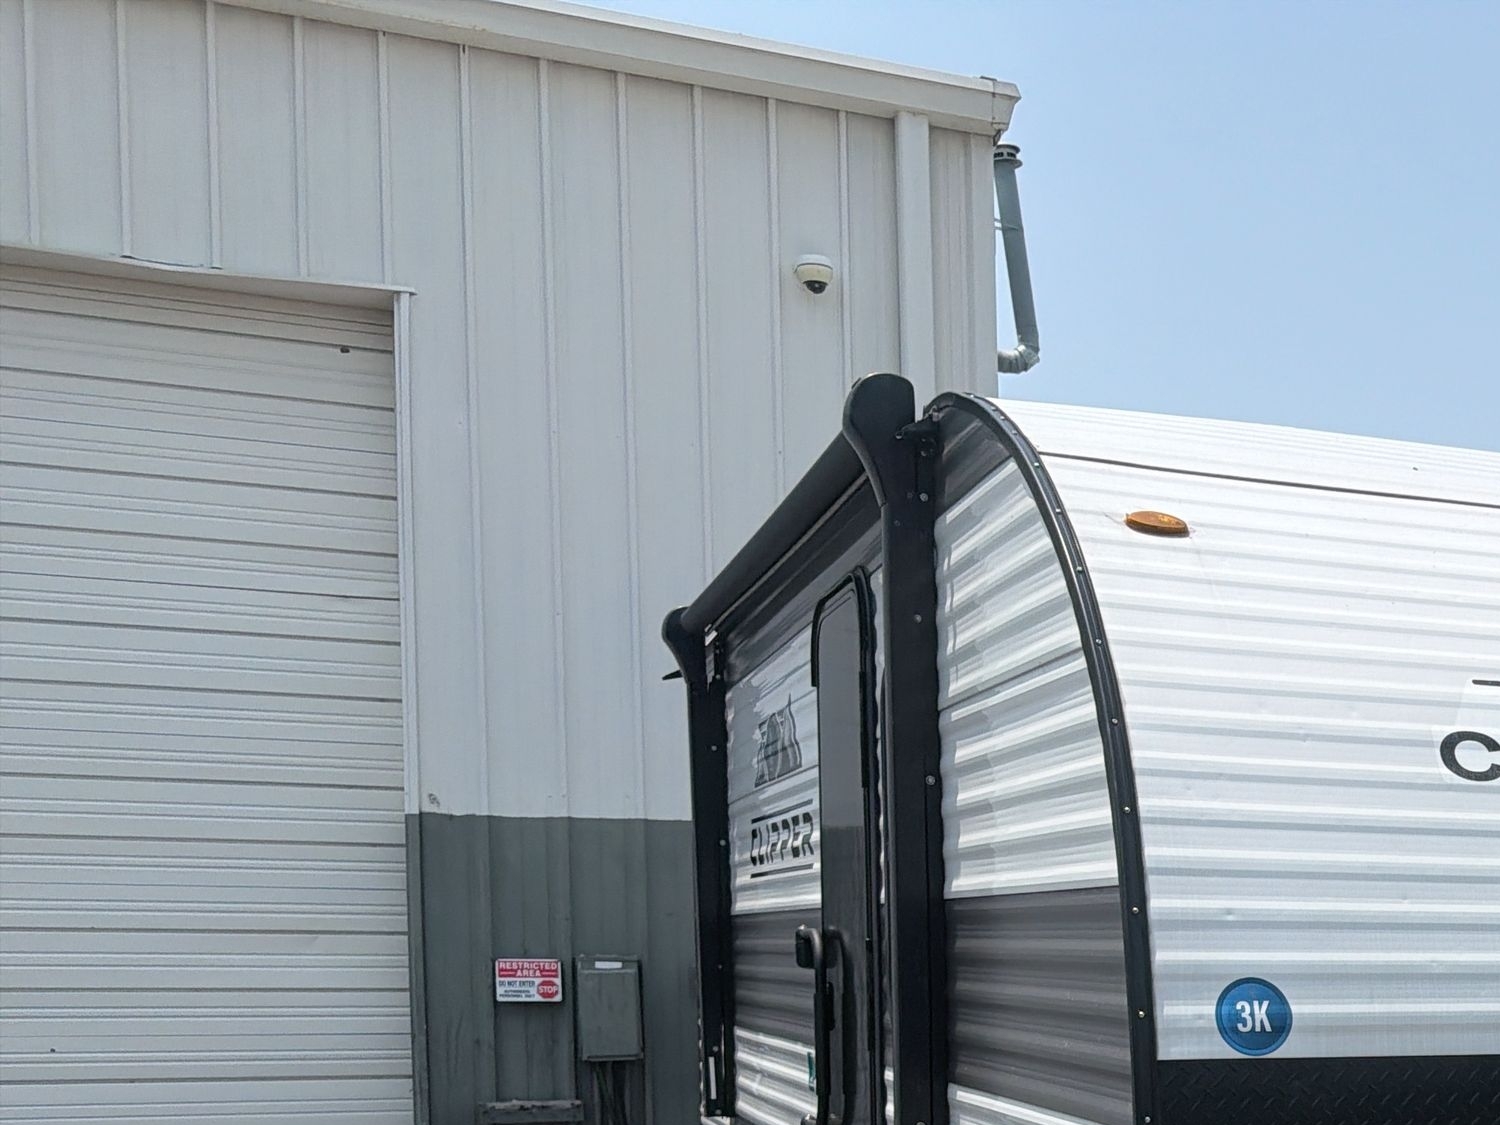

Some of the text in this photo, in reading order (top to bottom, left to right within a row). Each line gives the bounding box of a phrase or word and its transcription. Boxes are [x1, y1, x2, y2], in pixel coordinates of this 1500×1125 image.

[750, 811, 815, 867] CLIPPER
[499, 961, 558, 970] RESTRICTED
[515, 969, 542, 977] AREA
[538, 985, 559, 994] STOP
[1235, 1000, 1272, 1033] 3K
